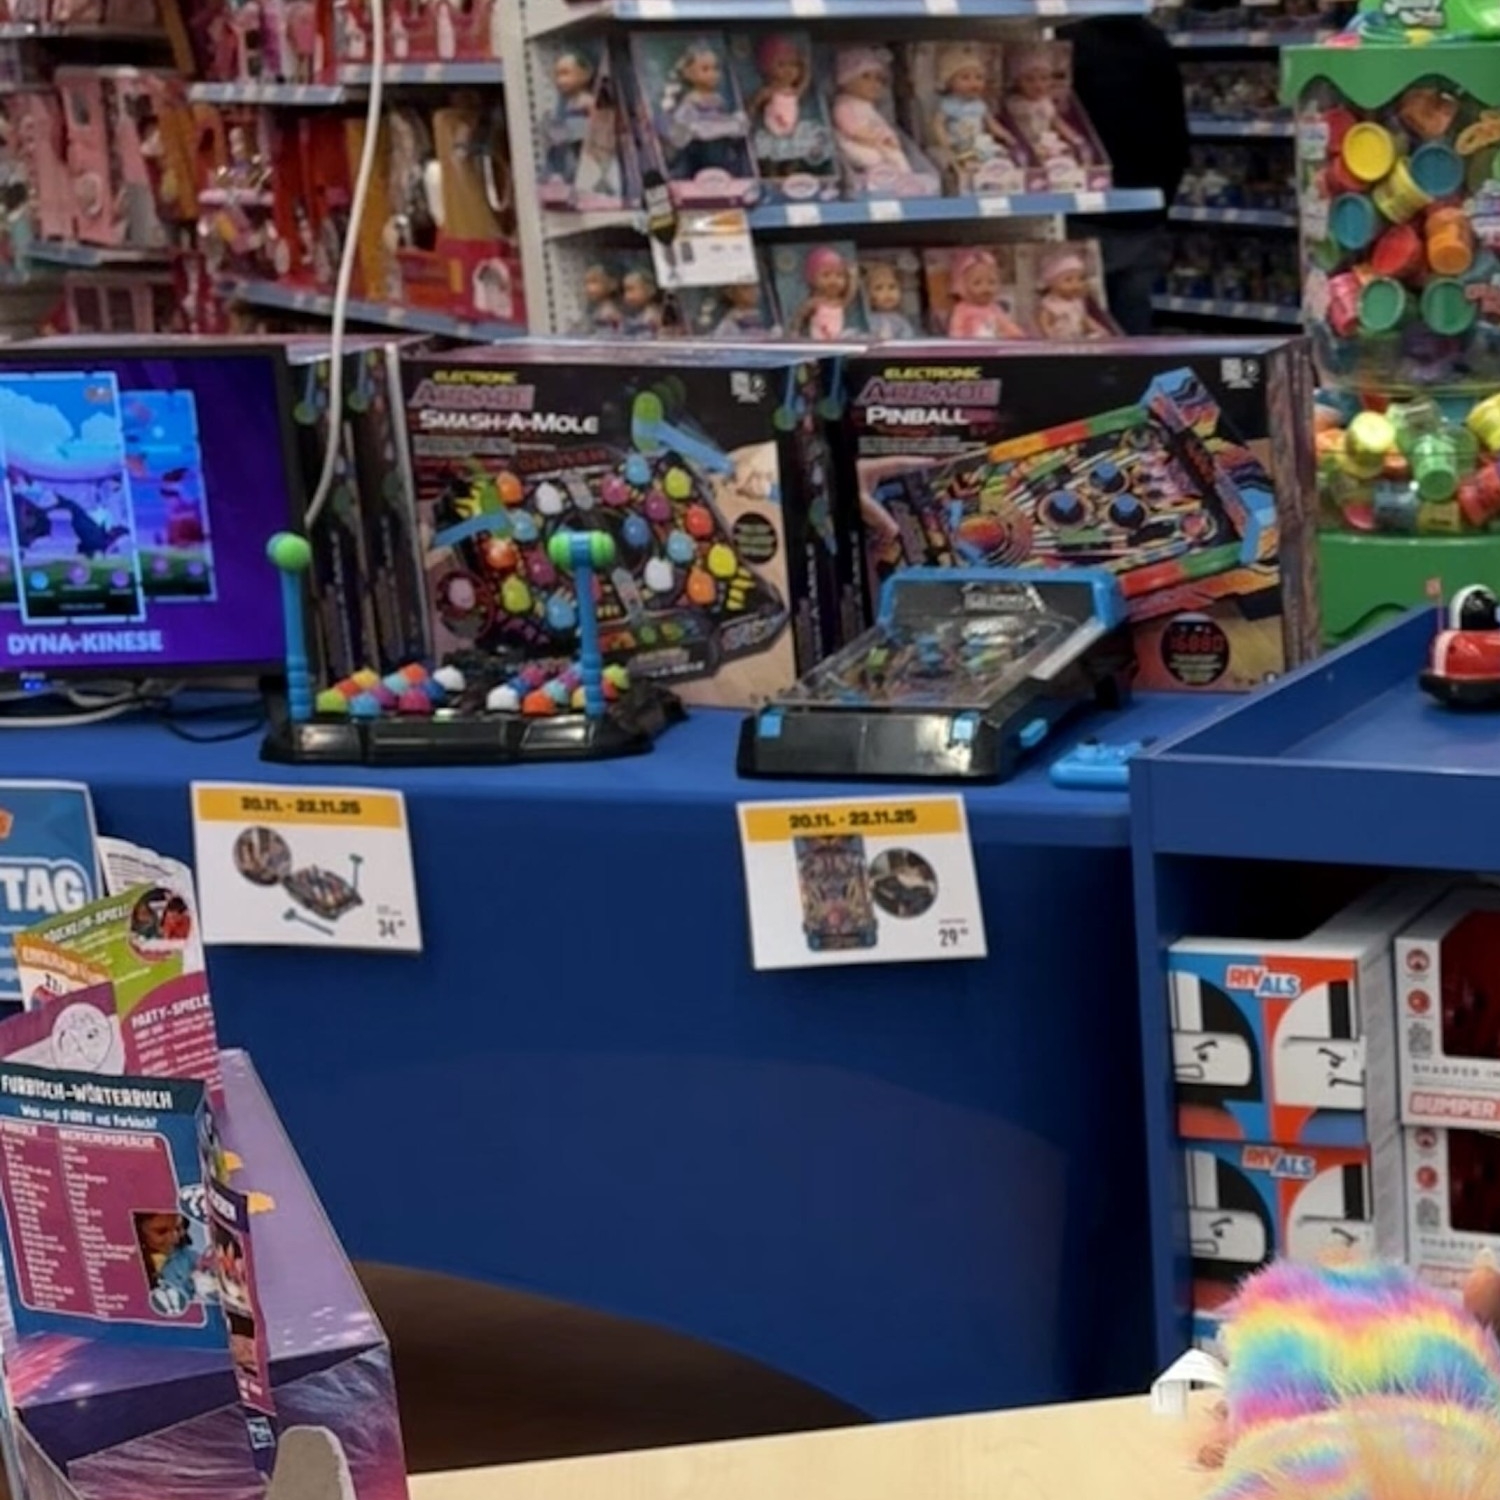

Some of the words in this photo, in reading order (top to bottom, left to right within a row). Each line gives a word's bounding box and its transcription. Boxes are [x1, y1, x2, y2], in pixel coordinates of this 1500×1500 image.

[419, 409, 600, 435] SMASH-A-MOLE
[866, 405, 971, 425] PINBALL
[7, 630, 163, 655] DYNA-KINESE
[789, 813, 835, 829] 20.11.
